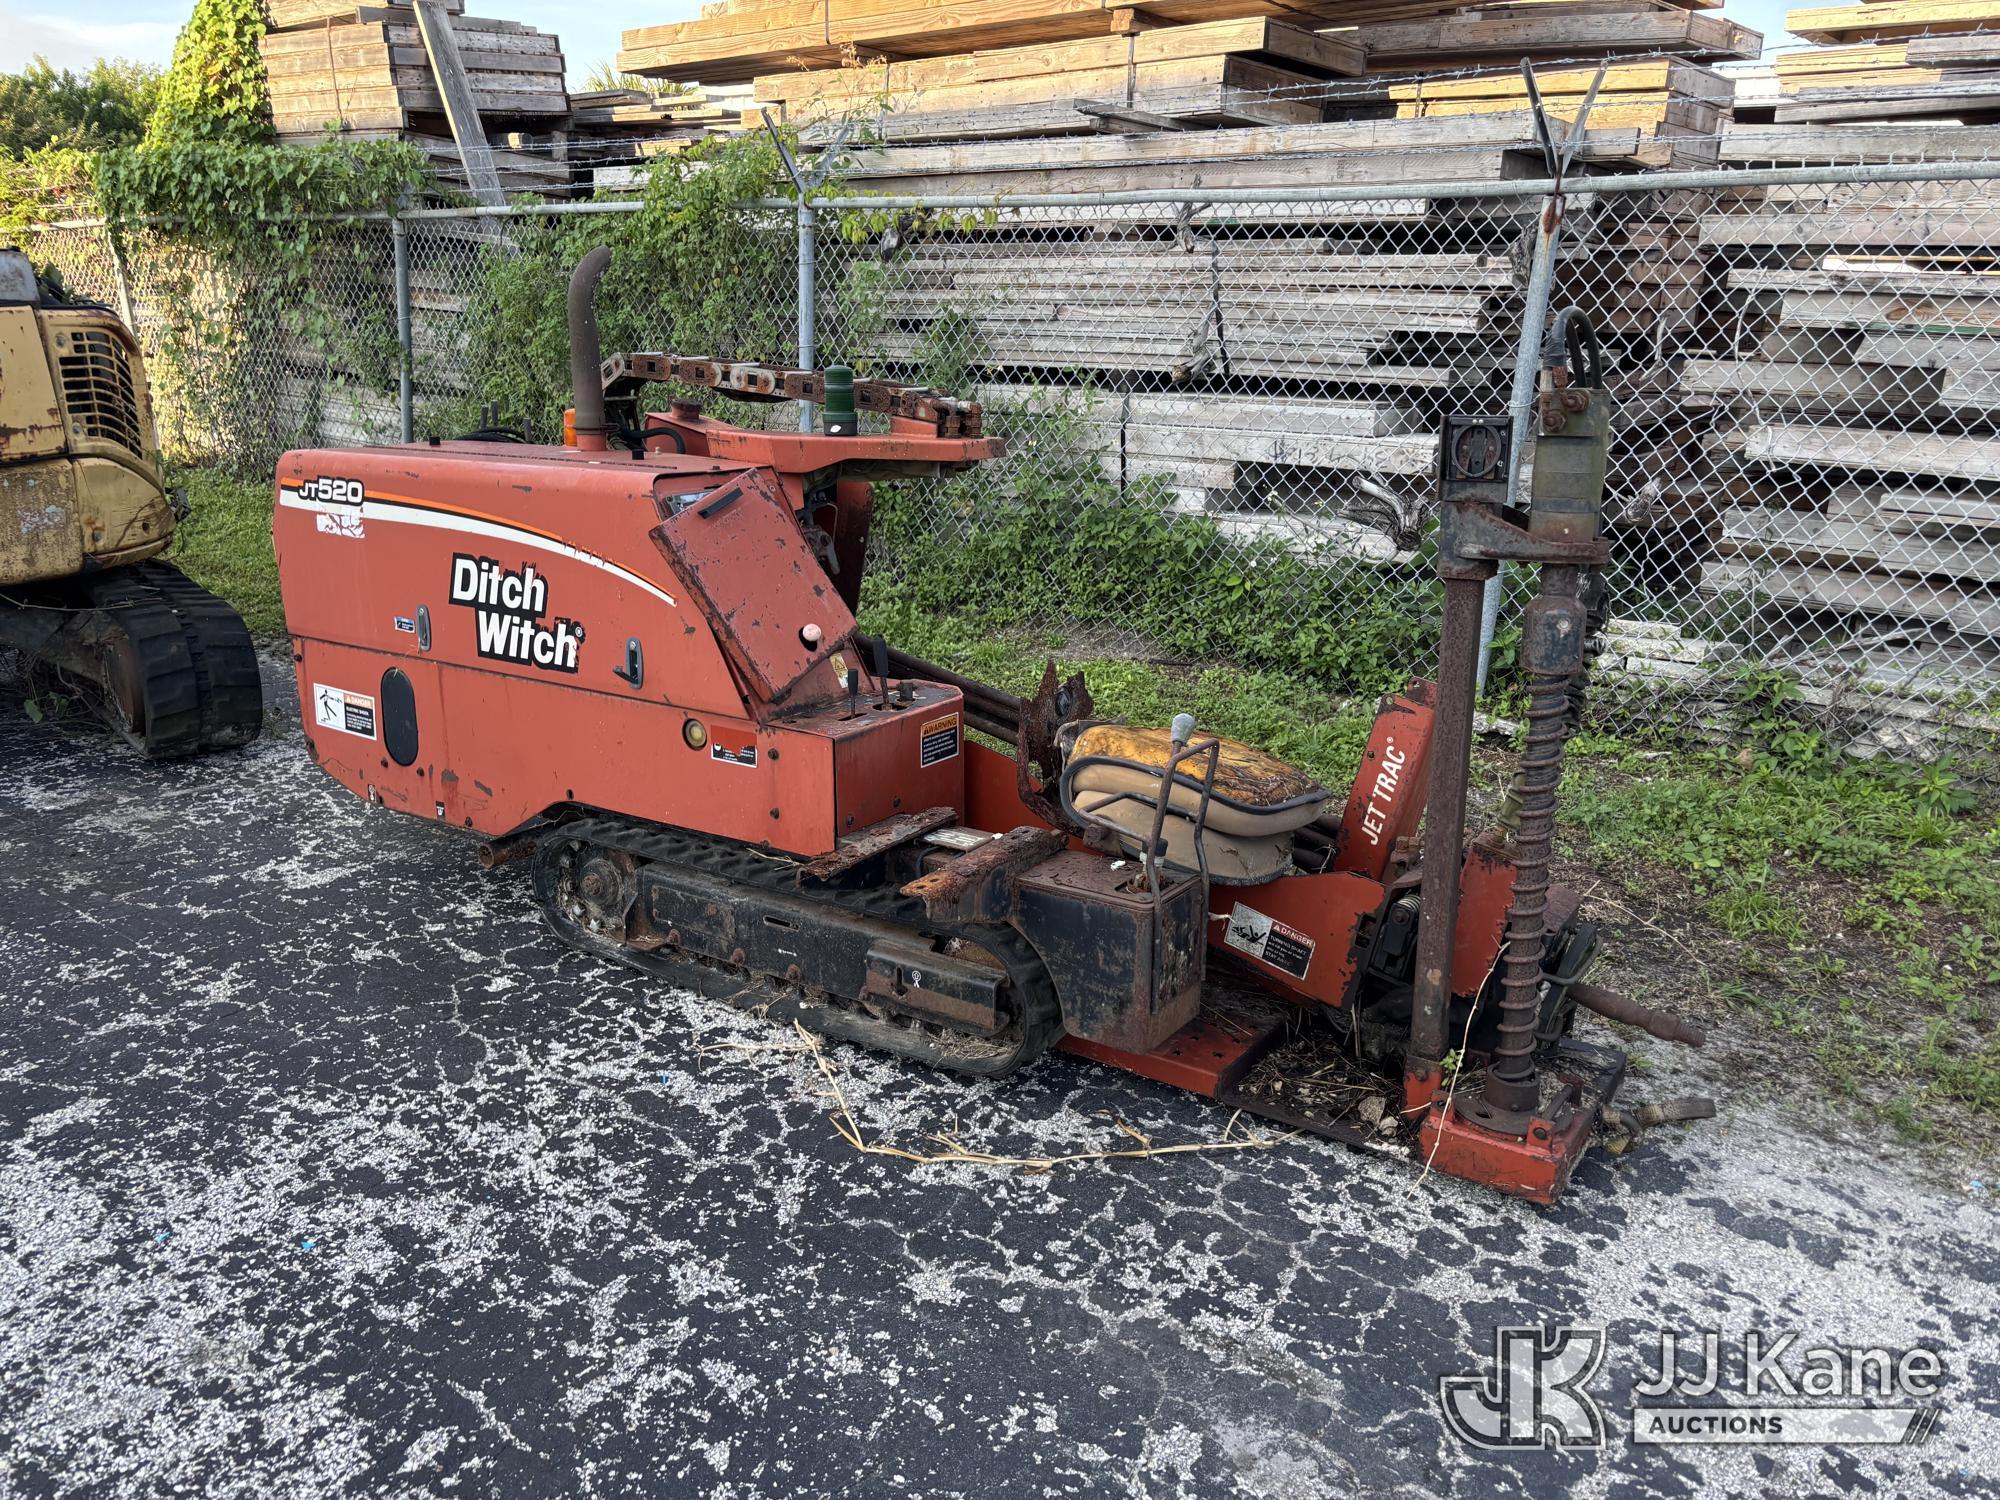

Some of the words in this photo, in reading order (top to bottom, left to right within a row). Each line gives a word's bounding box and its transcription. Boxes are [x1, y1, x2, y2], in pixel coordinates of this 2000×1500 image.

[298, 477, 363, 504] JT520
[452, 557, 545, 612] Ditch
[927, 717, 957, 732] WARNING
[1361, 801, 1386, 846] JET
[1281, 927, 1312, 946] DANGER
